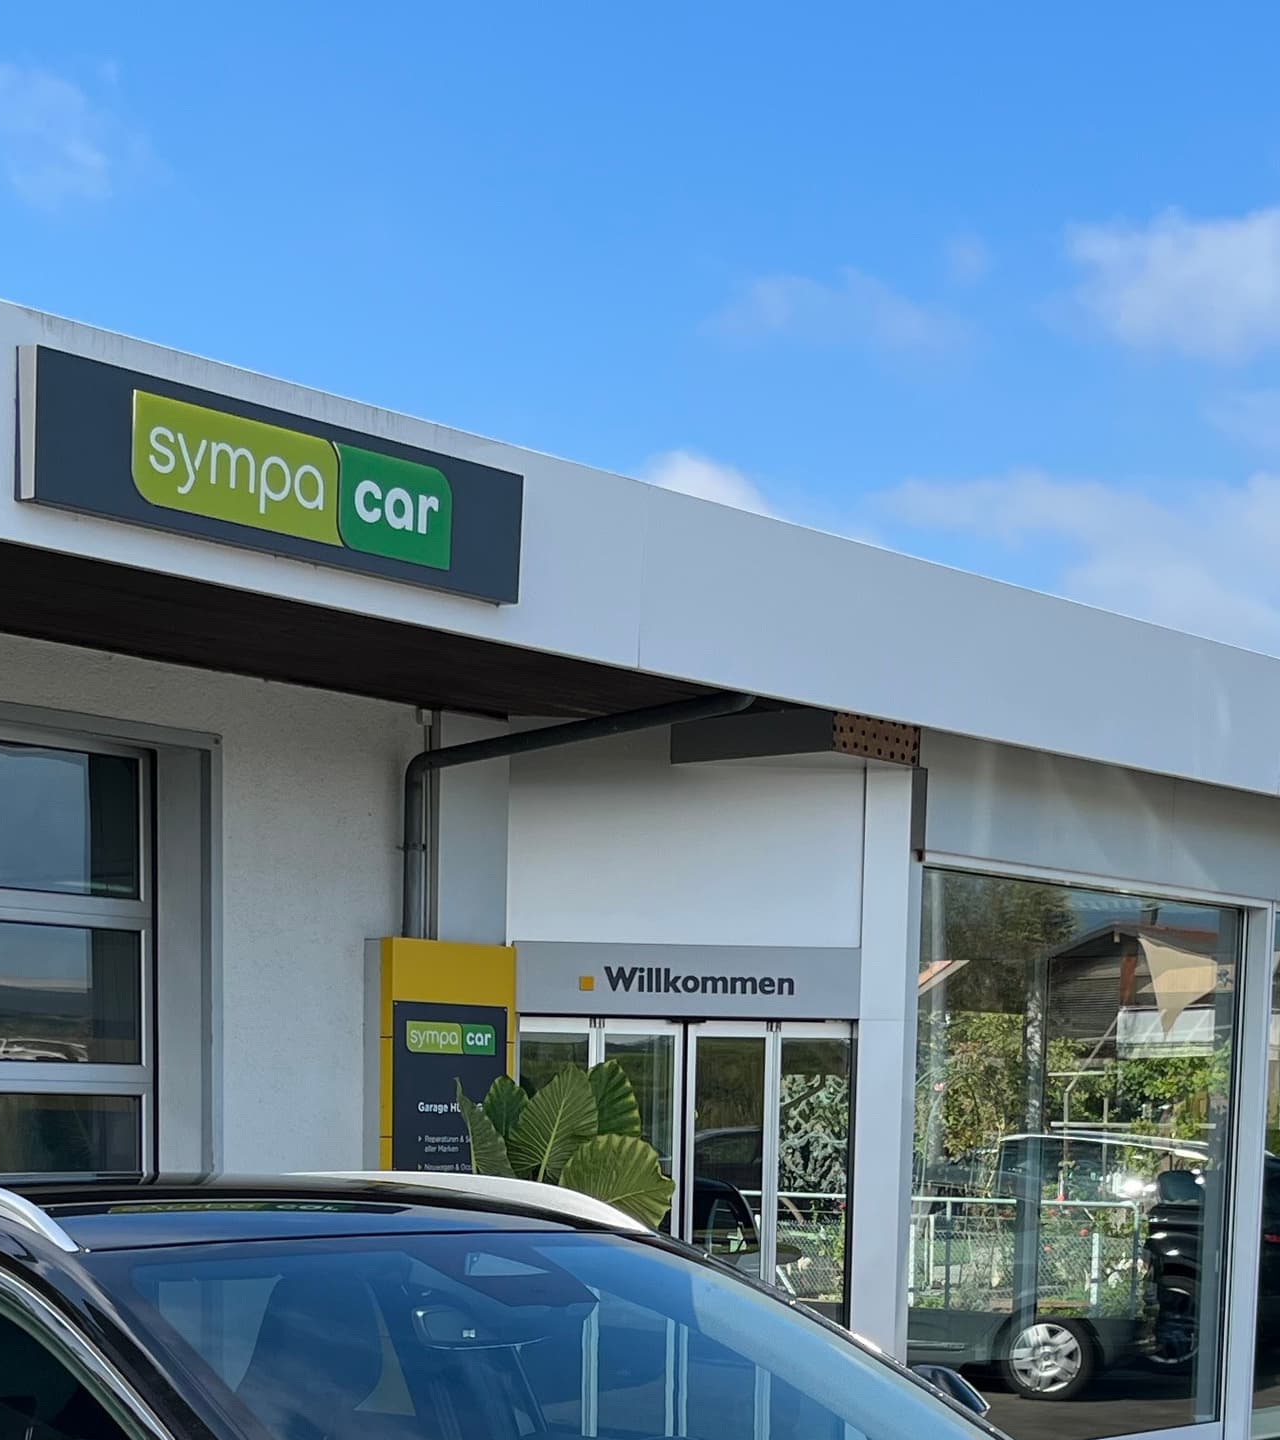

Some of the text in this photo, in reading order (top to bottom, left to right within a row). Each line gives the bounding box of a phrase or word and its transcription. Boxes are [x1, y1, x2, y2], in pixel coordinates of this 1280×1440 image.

[149, 425, 439, 535] sympa car
[604, 966, 795, 996] Willkommen
[410, 1030, 491, 1048] sympa car
[418, 1102, 448, 1114] Garage
[450, 1103, 461, 1112] HU
